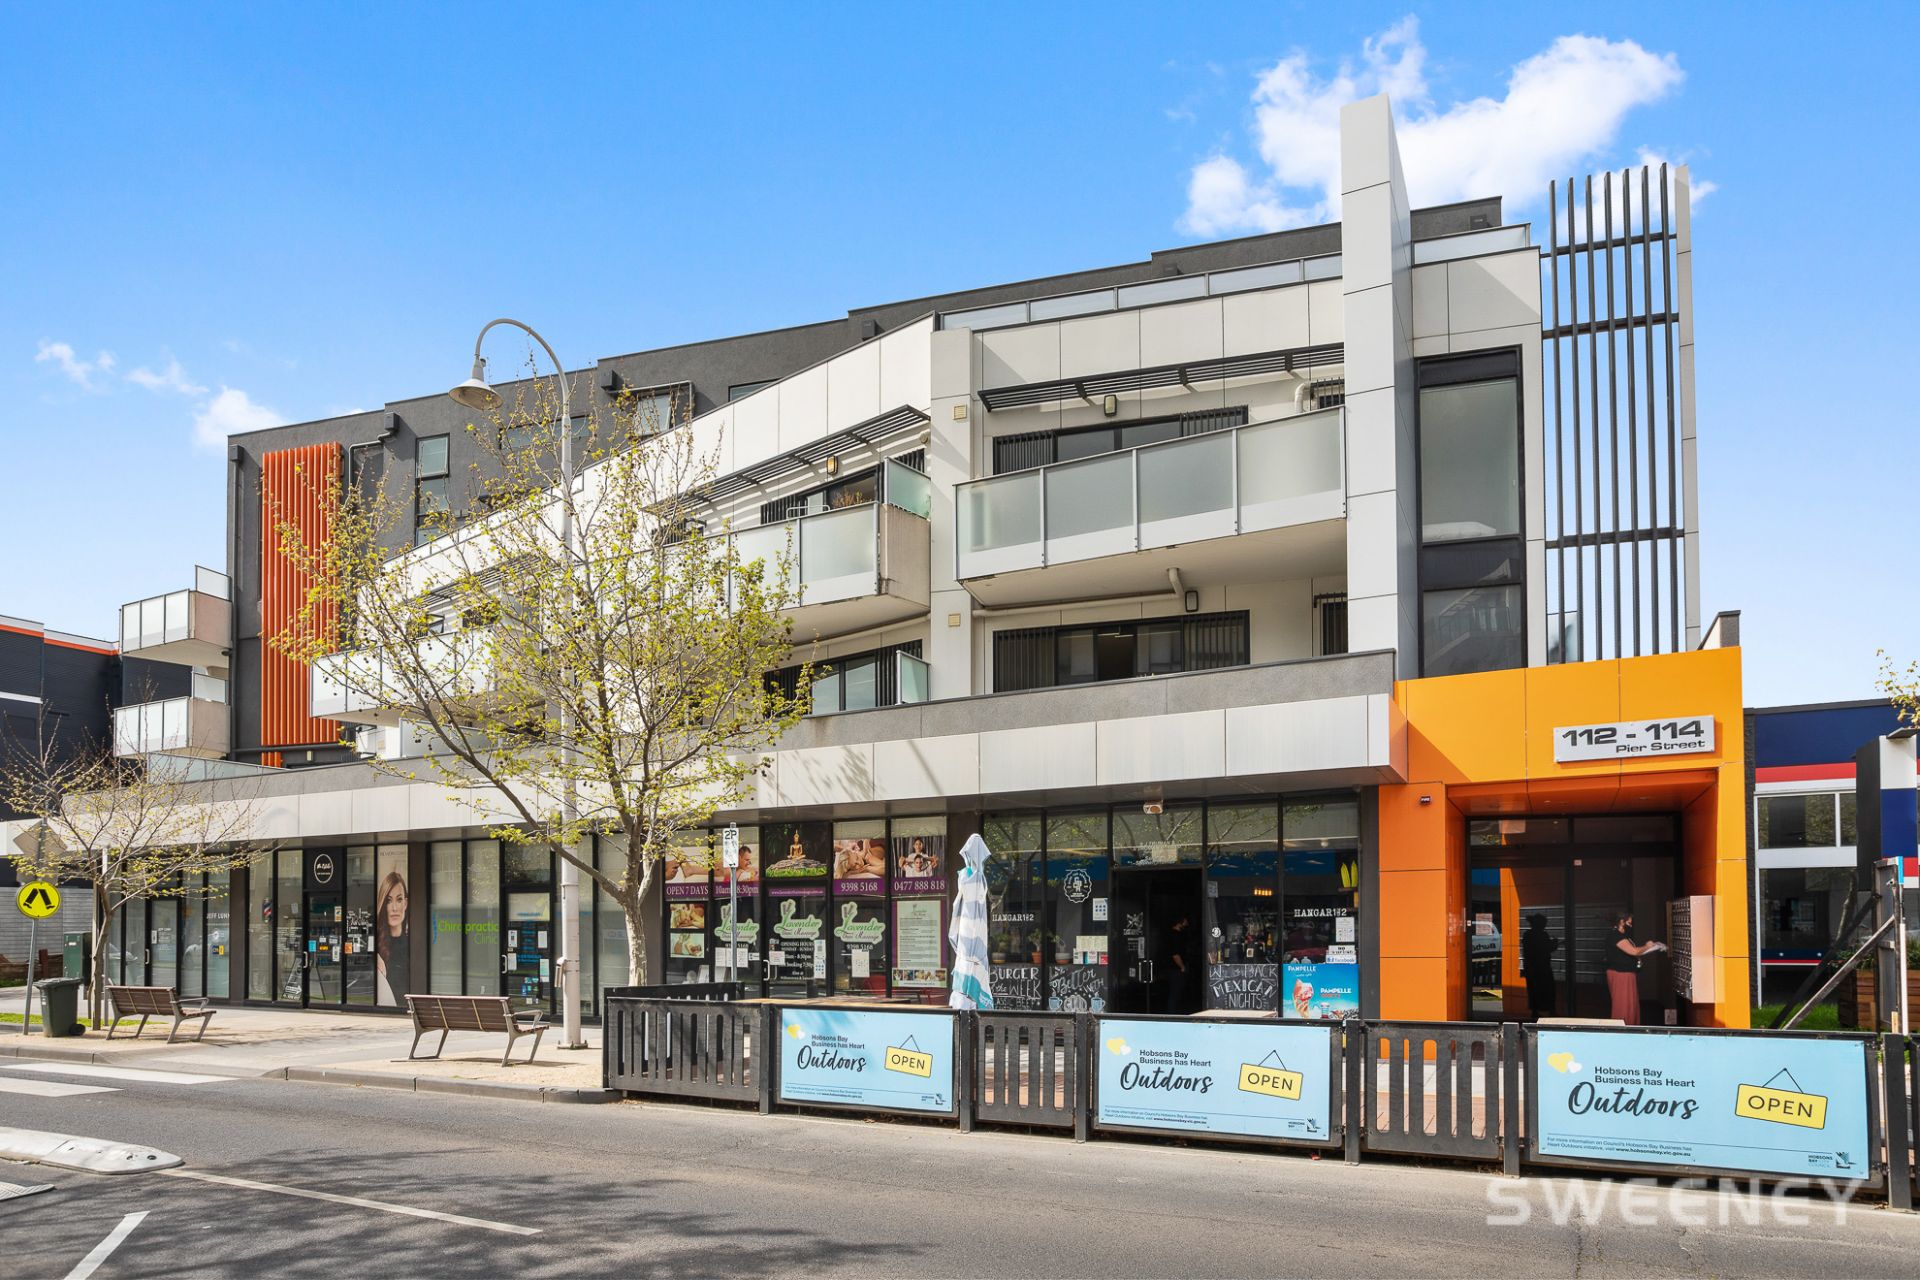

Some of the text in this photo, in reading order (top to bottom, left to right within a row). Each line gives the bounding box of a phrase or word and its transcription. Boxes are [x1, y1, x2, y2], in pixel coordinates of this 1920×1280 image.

[1562, 727, 1617, 747] 112
[1645, 720, 1704, 740] 114
[1616, 740, 1705, 753] Pier Street
[725, 830, 737, 840] 2P
[666, 885, 709, 895] OPEN 7 DAYS
[736, 884, 759, 896] 8:30pm
[841, 882, 878, 891] 9398 5168
[894, 880, 945, 891] 0477 888 818
[989, 966, 1039, 984] BURGER
[1009, 979, 1042, 999] WEEK
[1213, 979, 1277, 998] MEXICAN
[1229, 993, 1263, 1009] NIGHTS
[837, 1035, 849, 1043] Bay
[797, 1045, 867, 1072] Outdoors
[1139, 1049, 1189, 1059] Hobsons Bay
[891, 1054, 925, 1070] OPEN
[1139, 1057, 1211, 1067] Business has Heart
[1120, 1062, 1213, 1093] Outdoors
[1595, 1066, 1662, 1078] Hobsons Bay
[1247, 1072, 1293, 1091] OPEN
[1595, 1075, 1695, 1087] Business has Heart
[1568, 1081, 1699, 1119] Outdoors
[1748, 1095, 1813, 1118] OPEN
